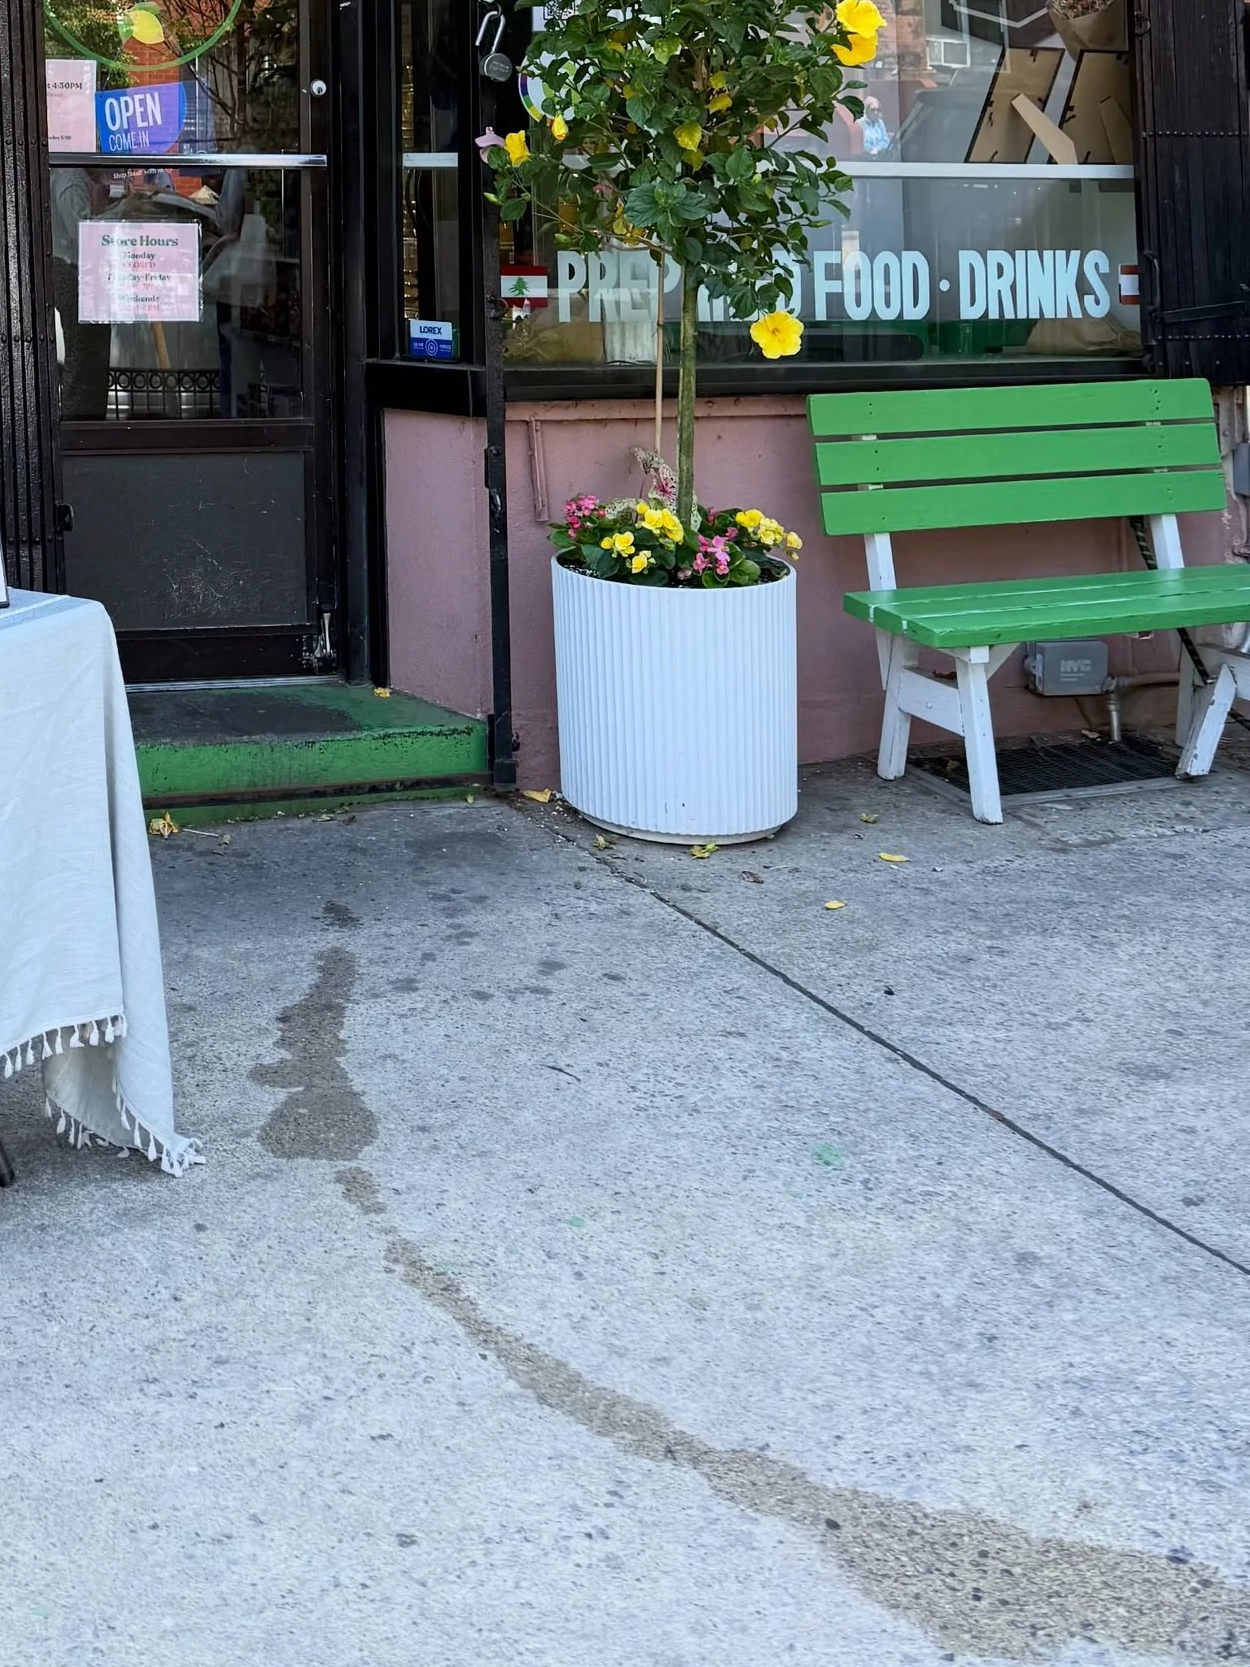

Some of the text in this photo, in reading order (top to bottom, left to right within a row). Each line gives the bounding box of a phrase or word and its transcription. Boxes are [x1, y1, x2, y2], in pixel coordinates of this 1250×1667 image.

[52, 82, 83, 90] 4:30PM
[105, 92, 162, 131] OPEN
[109, 130, 150, 152] COME IN
[101, 234, 178, 247] Store Hours
[123, 251, 156, 260] Monday
[557, 249, 1111, 323] PREPD FOOD DRINKS
[419, 325, 443, 335] LOREX
